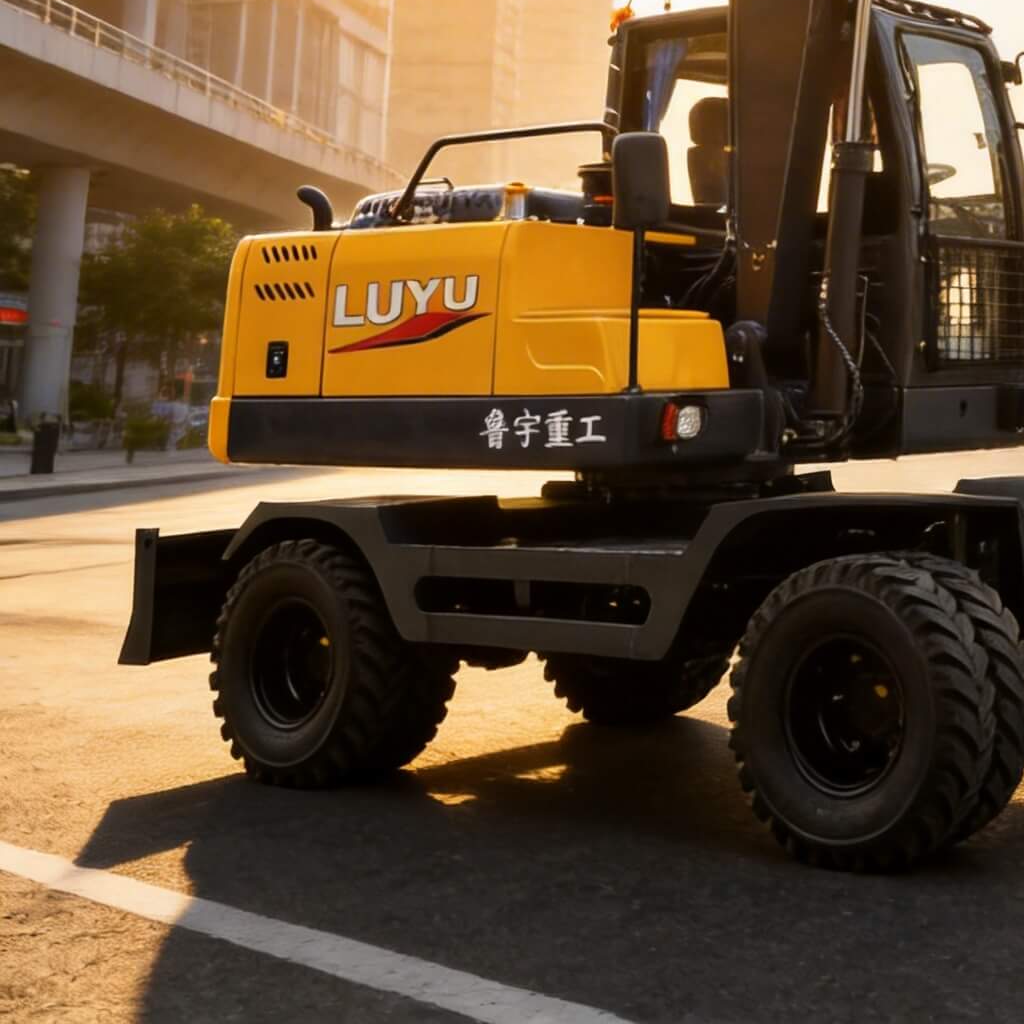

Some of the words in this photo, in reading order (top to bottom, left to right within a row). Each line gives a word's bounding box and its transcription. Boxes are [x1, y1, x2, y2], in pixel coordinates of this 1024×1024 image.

[333, 275, 480, 327] LUYU
[479, 408, 607, 449] 鲁宇重工
